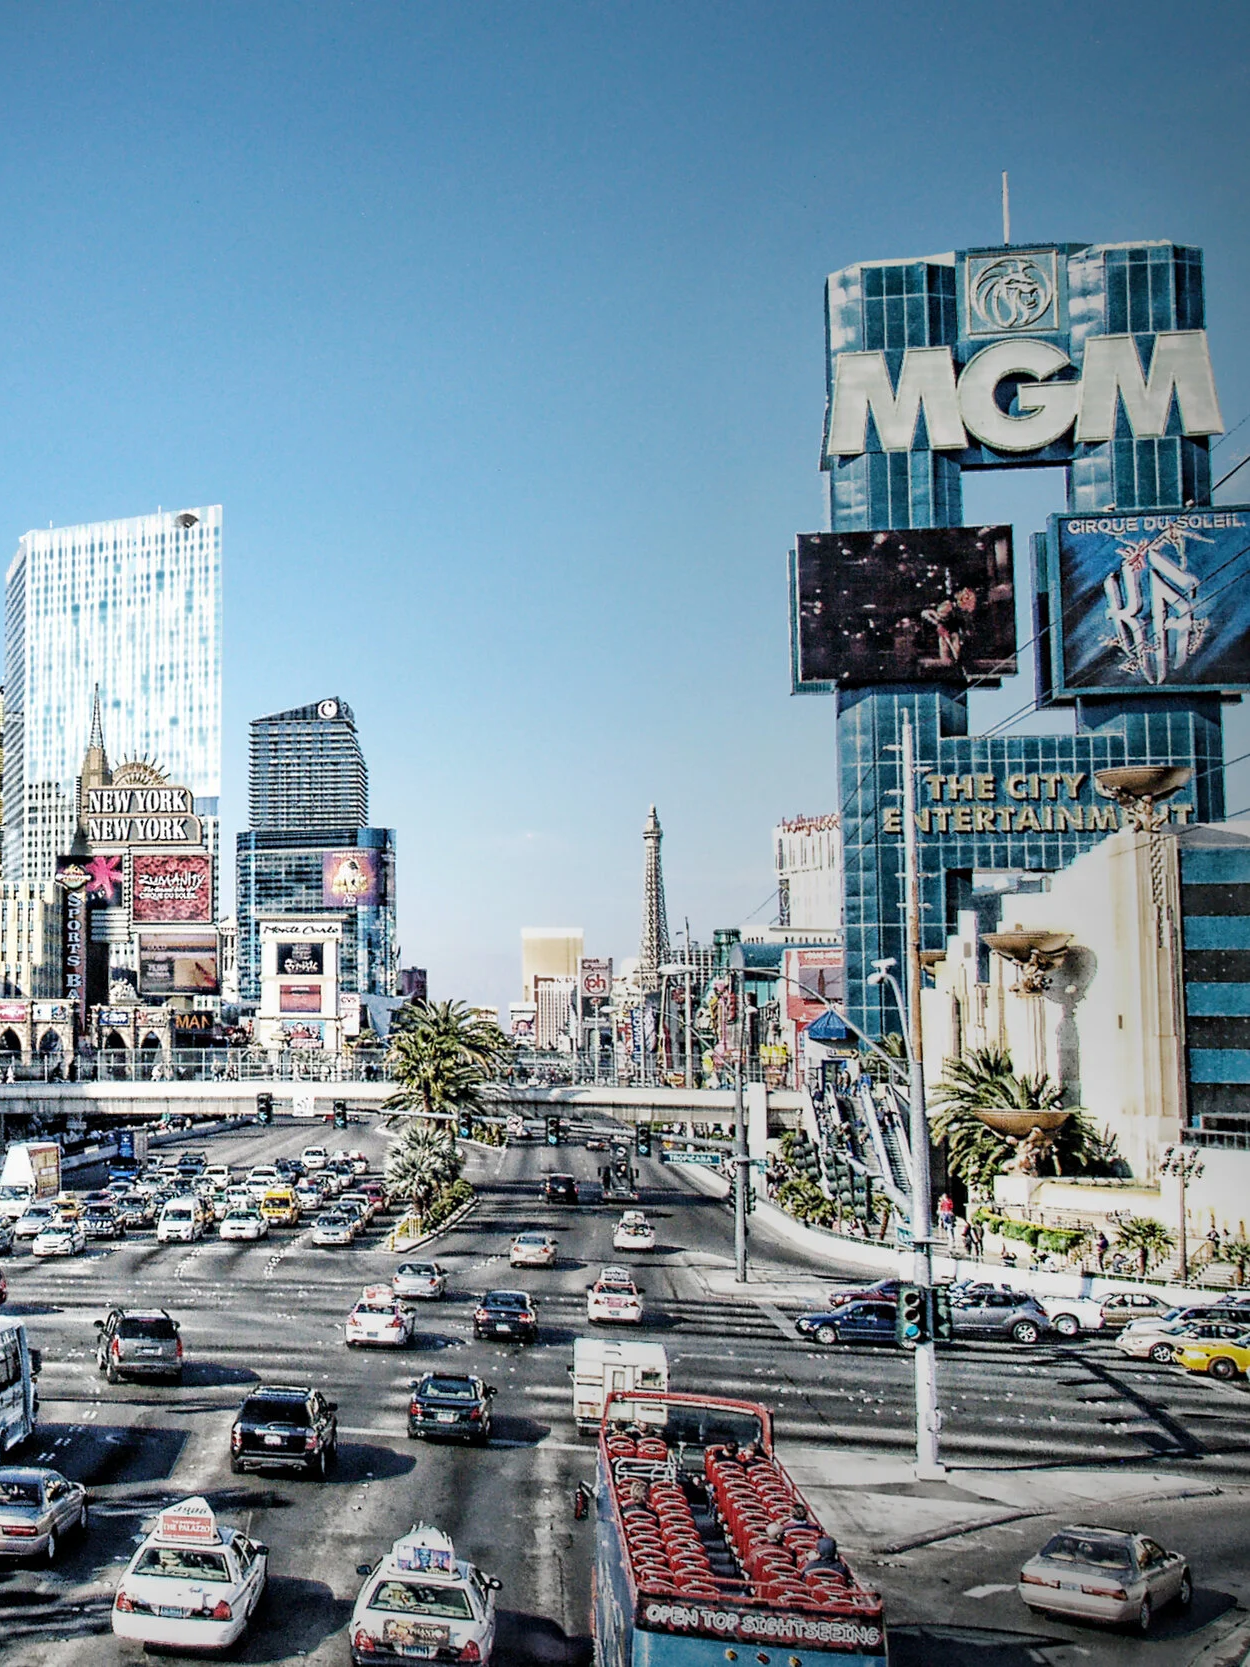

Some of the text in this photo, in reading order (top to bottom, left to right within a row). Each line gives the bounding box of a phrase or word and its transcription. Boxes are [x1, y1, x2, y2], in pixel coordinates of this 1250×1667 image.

[827, 330, 1224, 456] MGM
[1144, 516, 1170, 531] DU
[926, 772, 1086, 800] THE CITY
[89, 789, 188, 813] NEW YORK
[89, 817, 188, 841] NEW YORK
[883, 804, 1194, 834] ENTERTAINMT
[138, 871, 206, 891] ZUMANITY
[66, 891, 82, 967] SPORTS
[263, 925, 339, 935] Monte Carlo
[65, 973, 83, 999] BA
[669, 1154, 712, 1163] TROPICANA
[178, 1523, 210, 1533] PALAZZO
[646, 1603, 881, 1647] OPEN TOP SIGHTSEEING
